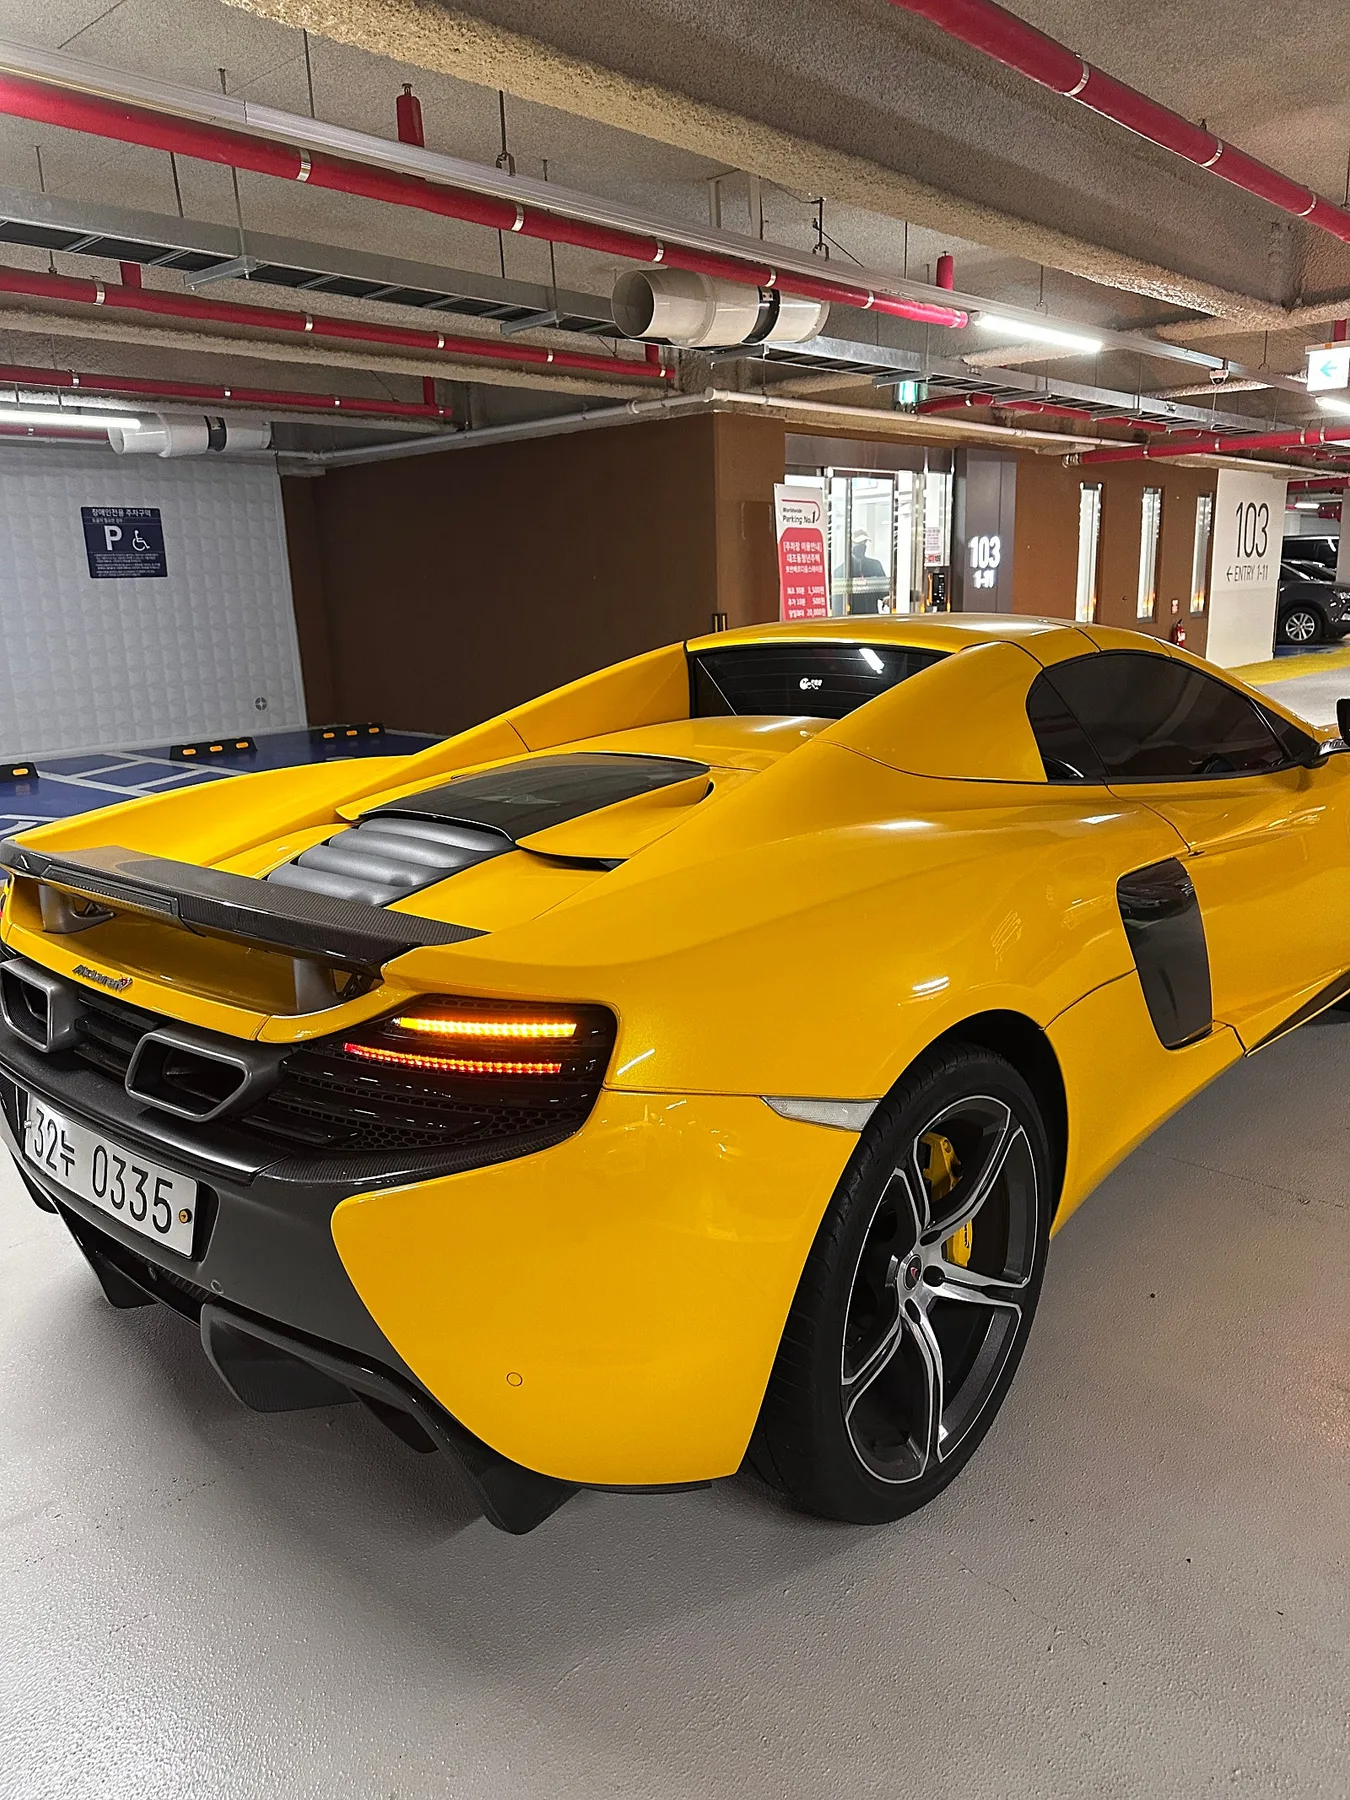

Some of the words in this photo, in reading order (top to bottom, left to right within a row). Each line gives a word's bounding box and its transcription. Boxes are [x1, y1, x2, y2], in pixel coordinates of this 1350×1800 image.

[91, 508, 124, 517] 장애인전용
[125, 509, 152, 517] 주차구역
[782, 515, 803, 525] Parking
[103, 525, 123, 551] P
[1235, 501, 1269, 558] 103
[967, 535, 1001, 569] 103
[1234, 565, 1256, 582] ENTRY
[1256, 564, 1269, 581] 1-11
[34, 1107, 75, 1177] 32누
[92, 1144, 173, 1234] 0335
